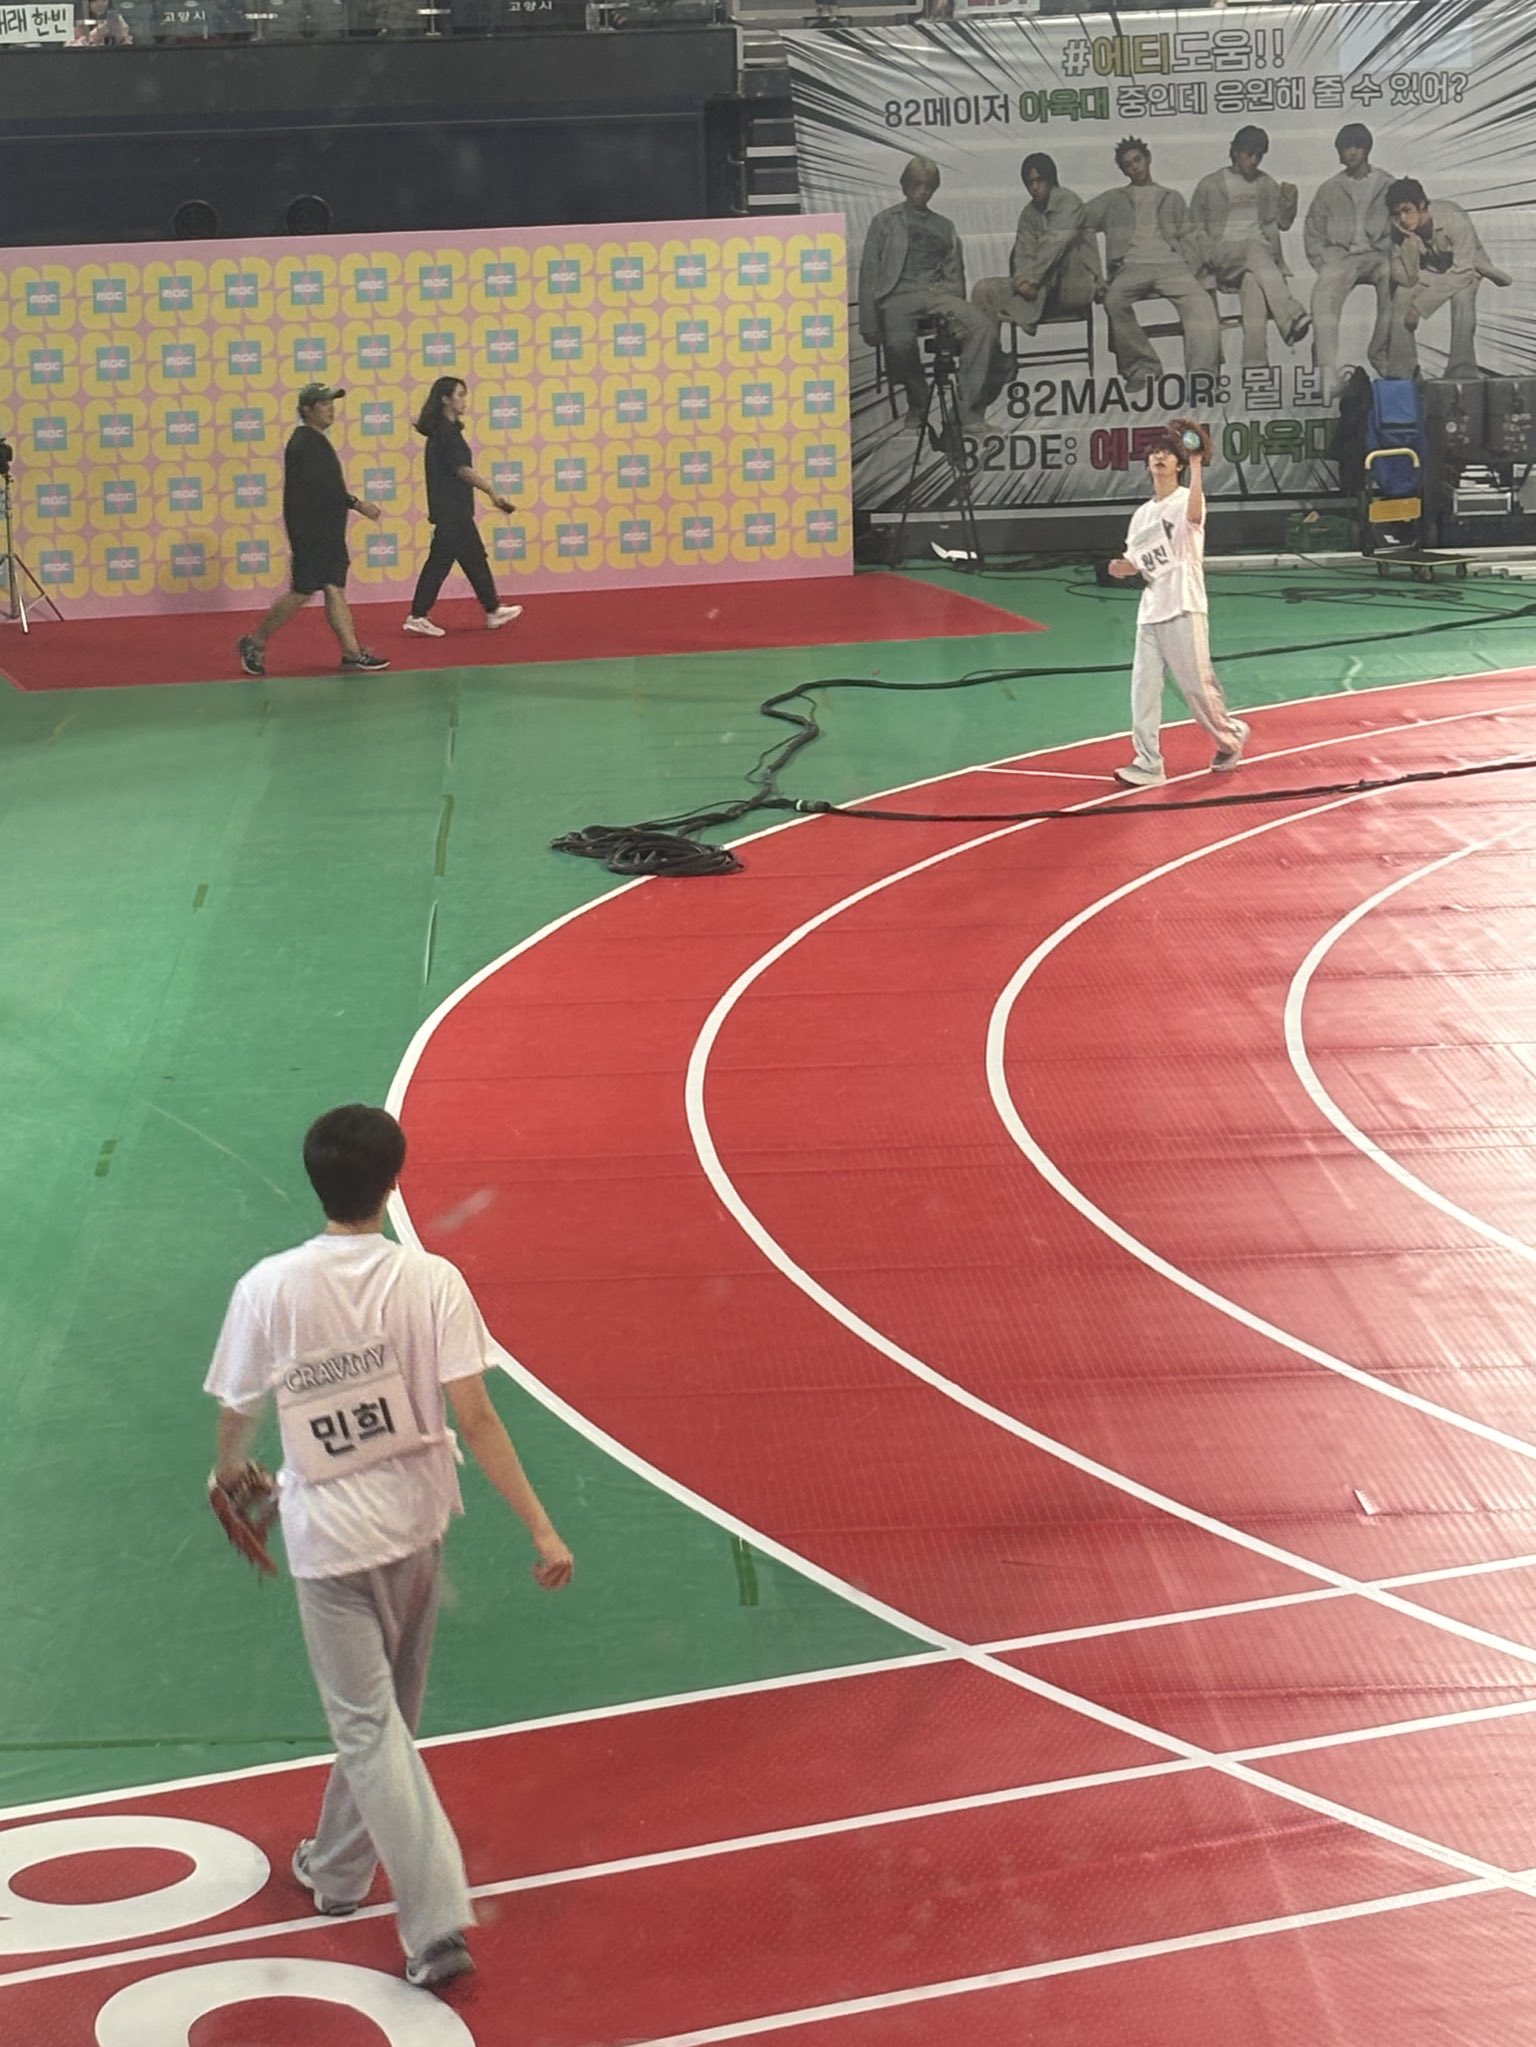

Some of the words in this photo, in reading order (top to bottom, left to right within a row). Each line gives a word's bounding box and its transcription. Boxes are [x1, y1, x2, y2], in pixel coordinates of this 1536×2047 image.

[31, 7, 67, 37] 한빈
[162, 10, 207, 23] 고양시
[508, 0, 553, 12] 고양시
[884, 94, 1010, 127] 82메이저
[1019, 87, 1109, 122] 아육대
[1117, 82, 1207, 119] 중인데
[1214, 76, 1306, 113] 응원해
[1313, 75, 1344, 109] 줄
[1350, 73, 1383, 106] 수
[1388, 72, 1468, 106] 있어?
[1242, 365, 1282, 411] 뭘
[286, 1344, 385, 1394] CRAVITY
[309, 1397, 396, 1457] 민희
